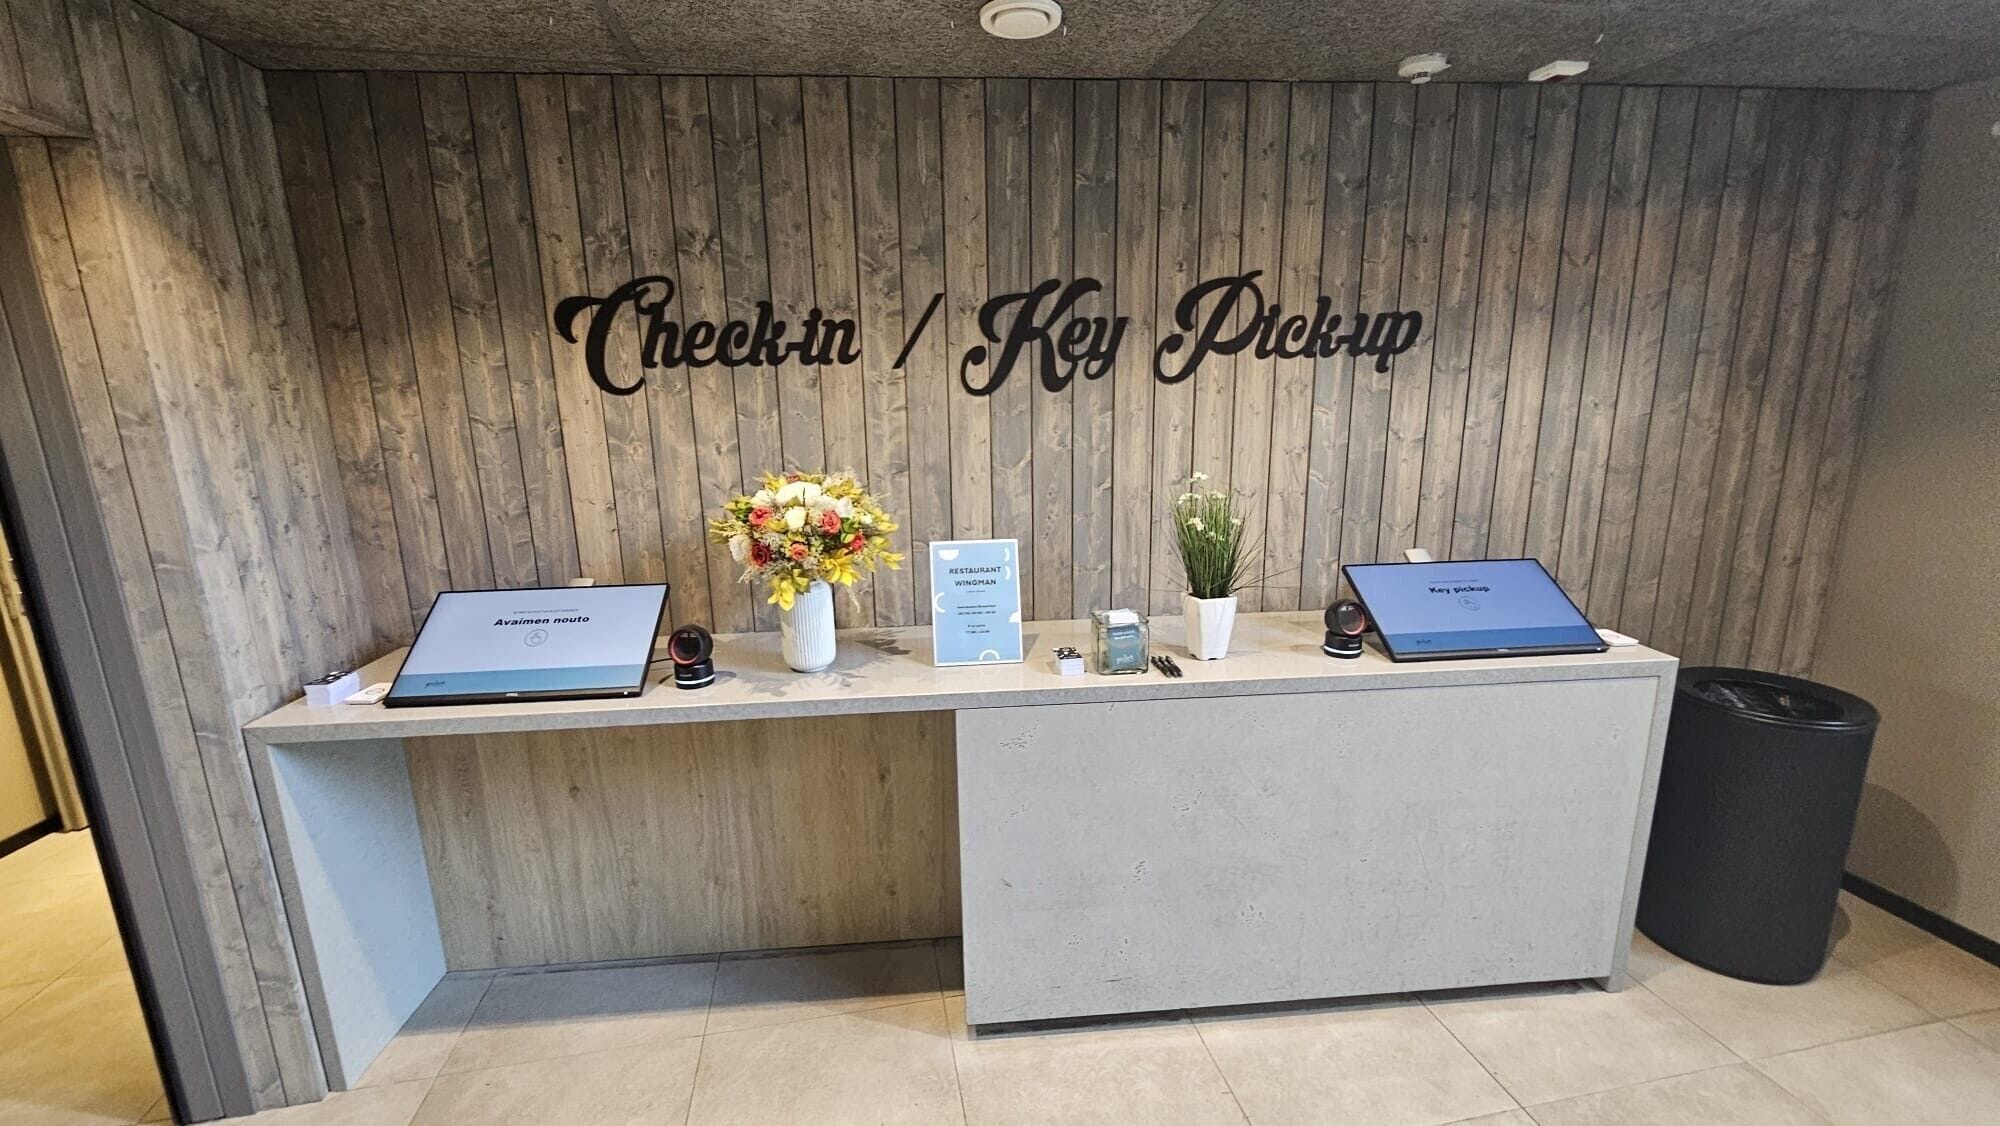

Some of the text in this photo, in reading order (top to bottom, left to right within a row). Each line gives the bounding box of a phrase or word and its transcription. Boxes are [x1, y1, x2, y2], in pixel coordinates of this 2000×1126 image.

[554, 270, 1423, 397] Check-in / Key Pick-up
[949, 566, 1001, 574] RESTAURANT
[493, 617, 549, 626] Avaimen
